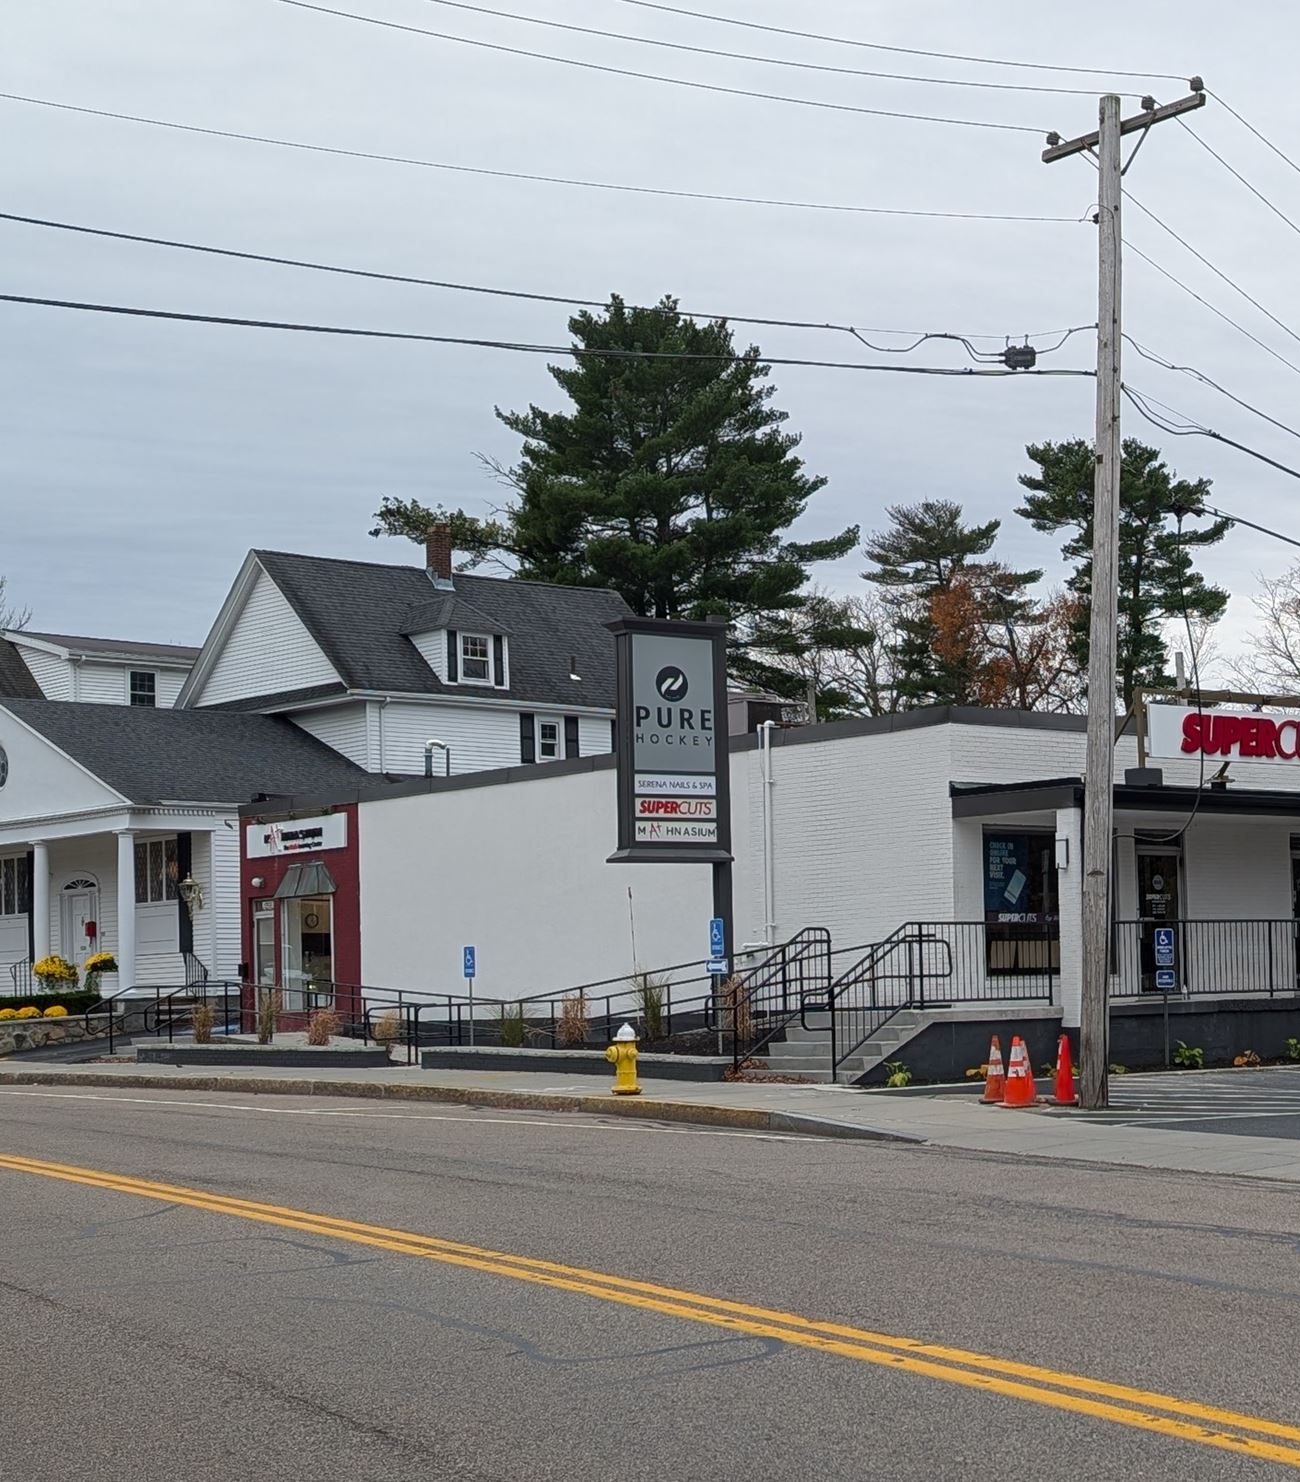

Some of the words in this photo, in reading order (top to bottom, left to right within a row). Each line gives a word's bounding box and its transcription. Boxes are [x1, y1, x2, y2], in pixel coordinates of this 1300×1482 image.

[636, 706, 712, 731] PURE
[636, 733, 713, 747] HOCKEY
[638, 780, 667, 788] SERENA
[669, 781, 690, 789] NAILS
[699, 782, 713, 790] SPA
[639, 800, 713, 815] SUPERCUTS
[998, 913, 1037, 922] SUPERCUTS
